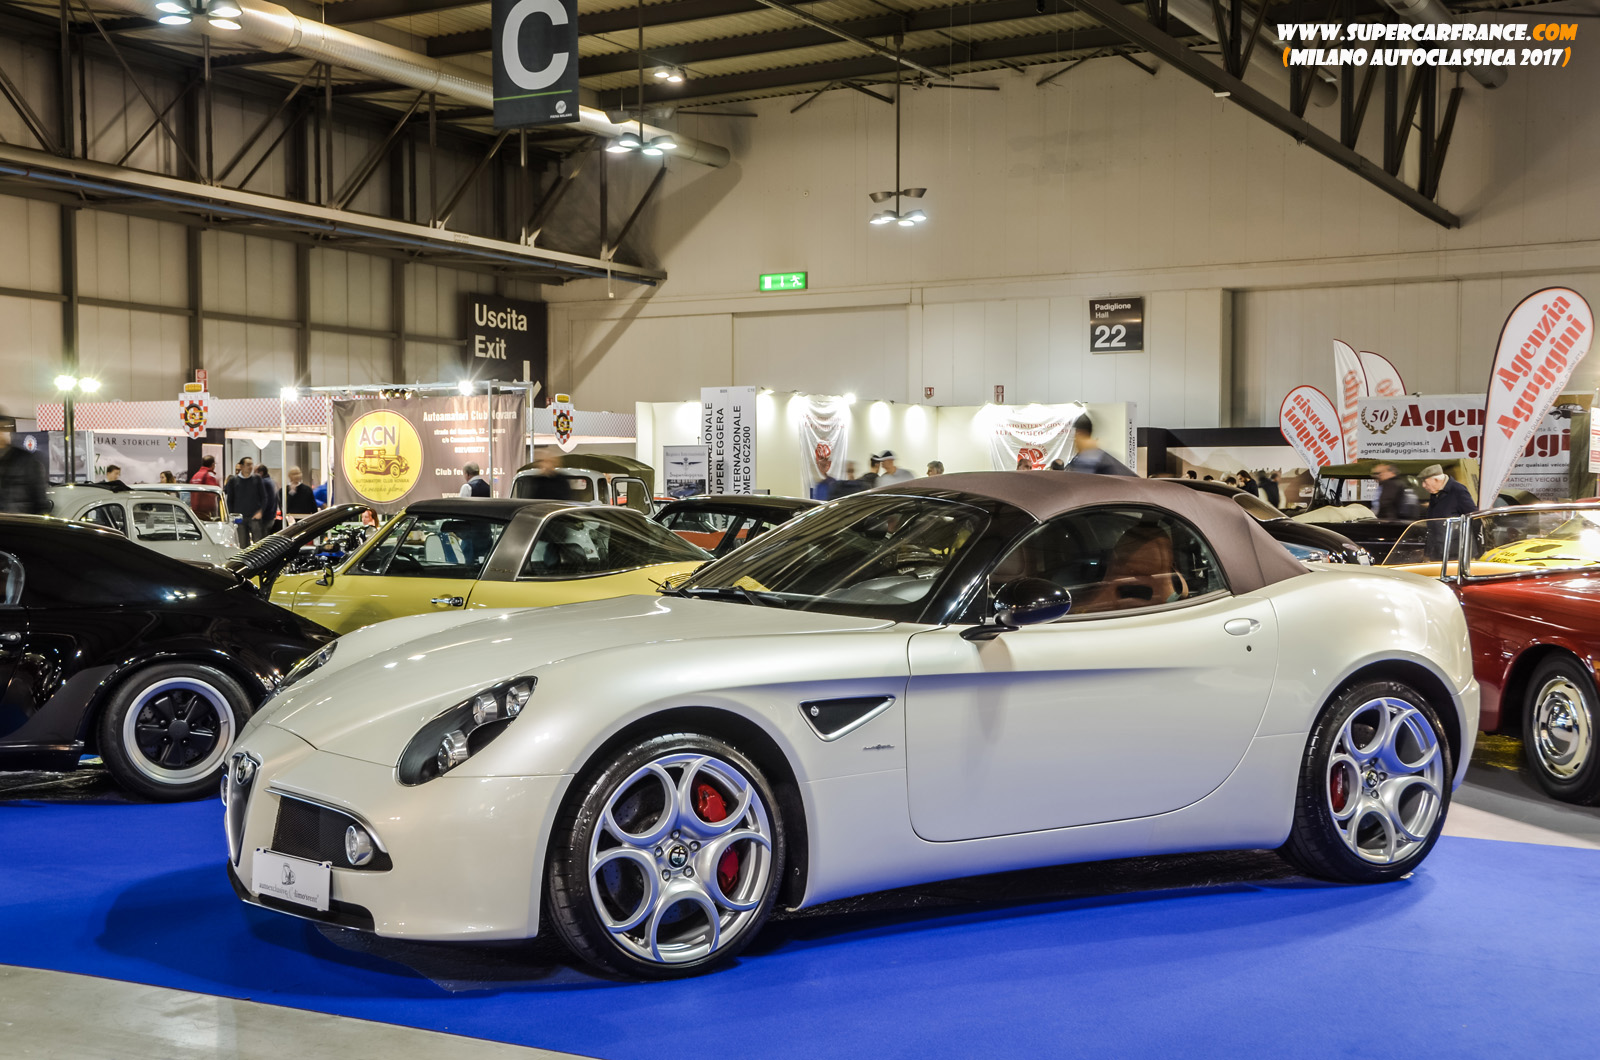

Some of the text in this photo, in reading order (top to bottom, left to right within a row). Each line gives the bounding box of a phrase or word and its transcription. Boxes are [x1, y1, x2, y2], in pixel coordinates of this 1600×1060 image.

[502, 0, 570, 90] C
[475, 303, 528, 331] Uscita
[1094, 303, 1132, 311] Padiglione
[475, 335, 507, 360] Exit
[1094, 325, 1127, 348] 22
[1496, 296, 1571, 392] Agenzia
[1496, 314, 1586, 440] Aguggini
[423, 411, 469, 422] Autoamatori
[471, 410, 488, 420] Club
[1370, 409, 1389, 423] 50
[1400, 404, 1486, 432] Agen
[93, 437, 161, 446] UAR STORICHE
[359, 425, 396, 446] ACN
[1366, 440, 1430, 448] www.agugginisas.it
[716, 408, 725, 494] UPERLEGGERA
[733, 405, 742, 494] NTERNAZIONALE
[743, 426, 751, 495] MEO 6C2500
[1360, 447, 1436, 455] agenzia@agugginisas.it
[435, 468, 452, 476] Club
